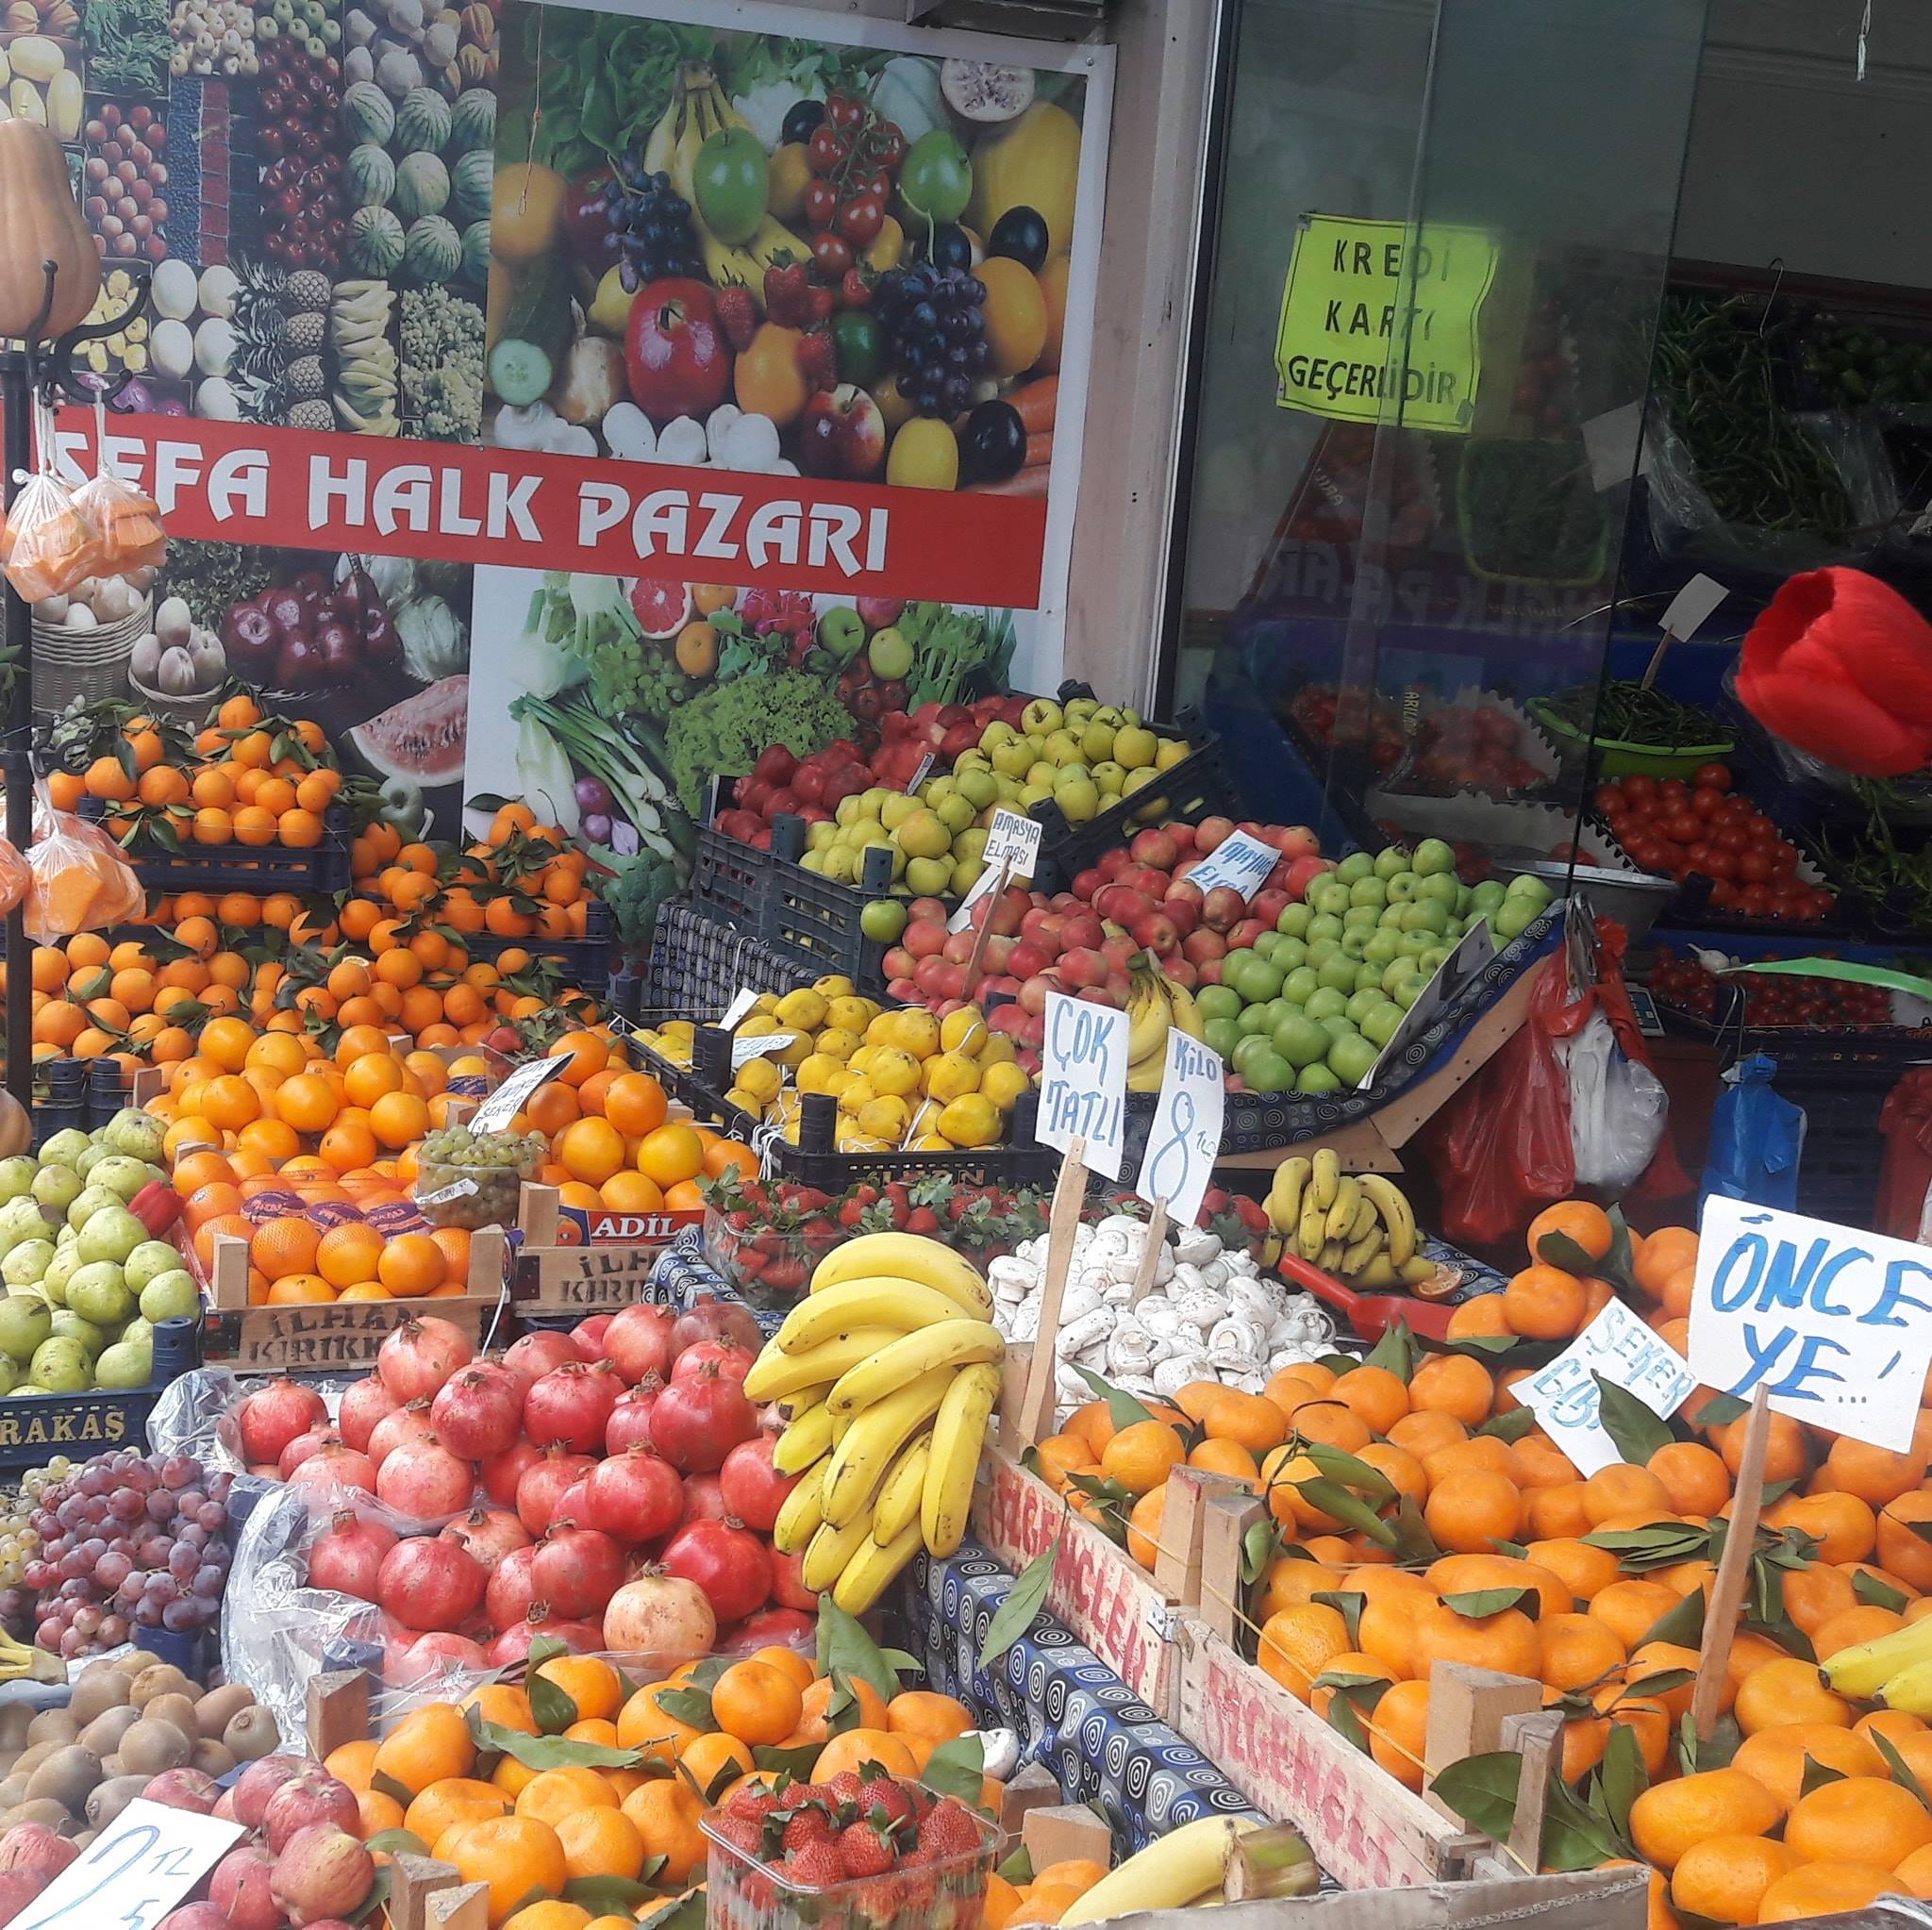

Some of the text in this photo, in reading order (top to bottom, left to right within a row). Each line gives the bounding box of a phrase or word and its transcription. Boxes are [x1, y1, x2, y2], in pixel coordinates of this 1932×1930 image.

[1332, 239, 1452, 282] KREDİ
[1288, 355, 1457, 406] GEÇERLİDİR
[55, 431, 890, 578] SEFA HALK PAZARI
[985, 840, 1029, 866] ELMASI
[992, 812, 1041, 845] AMASYA
[1052, 998, 1115, 1088] ÇOK
[1045, 1079, 1121, 1147] TATLI
[1149, 1090, 1194, 1205] 8
[591, 1212, 682, 1238] ADİL
[1710, 1213, 1932, 1328] ÖNCE
